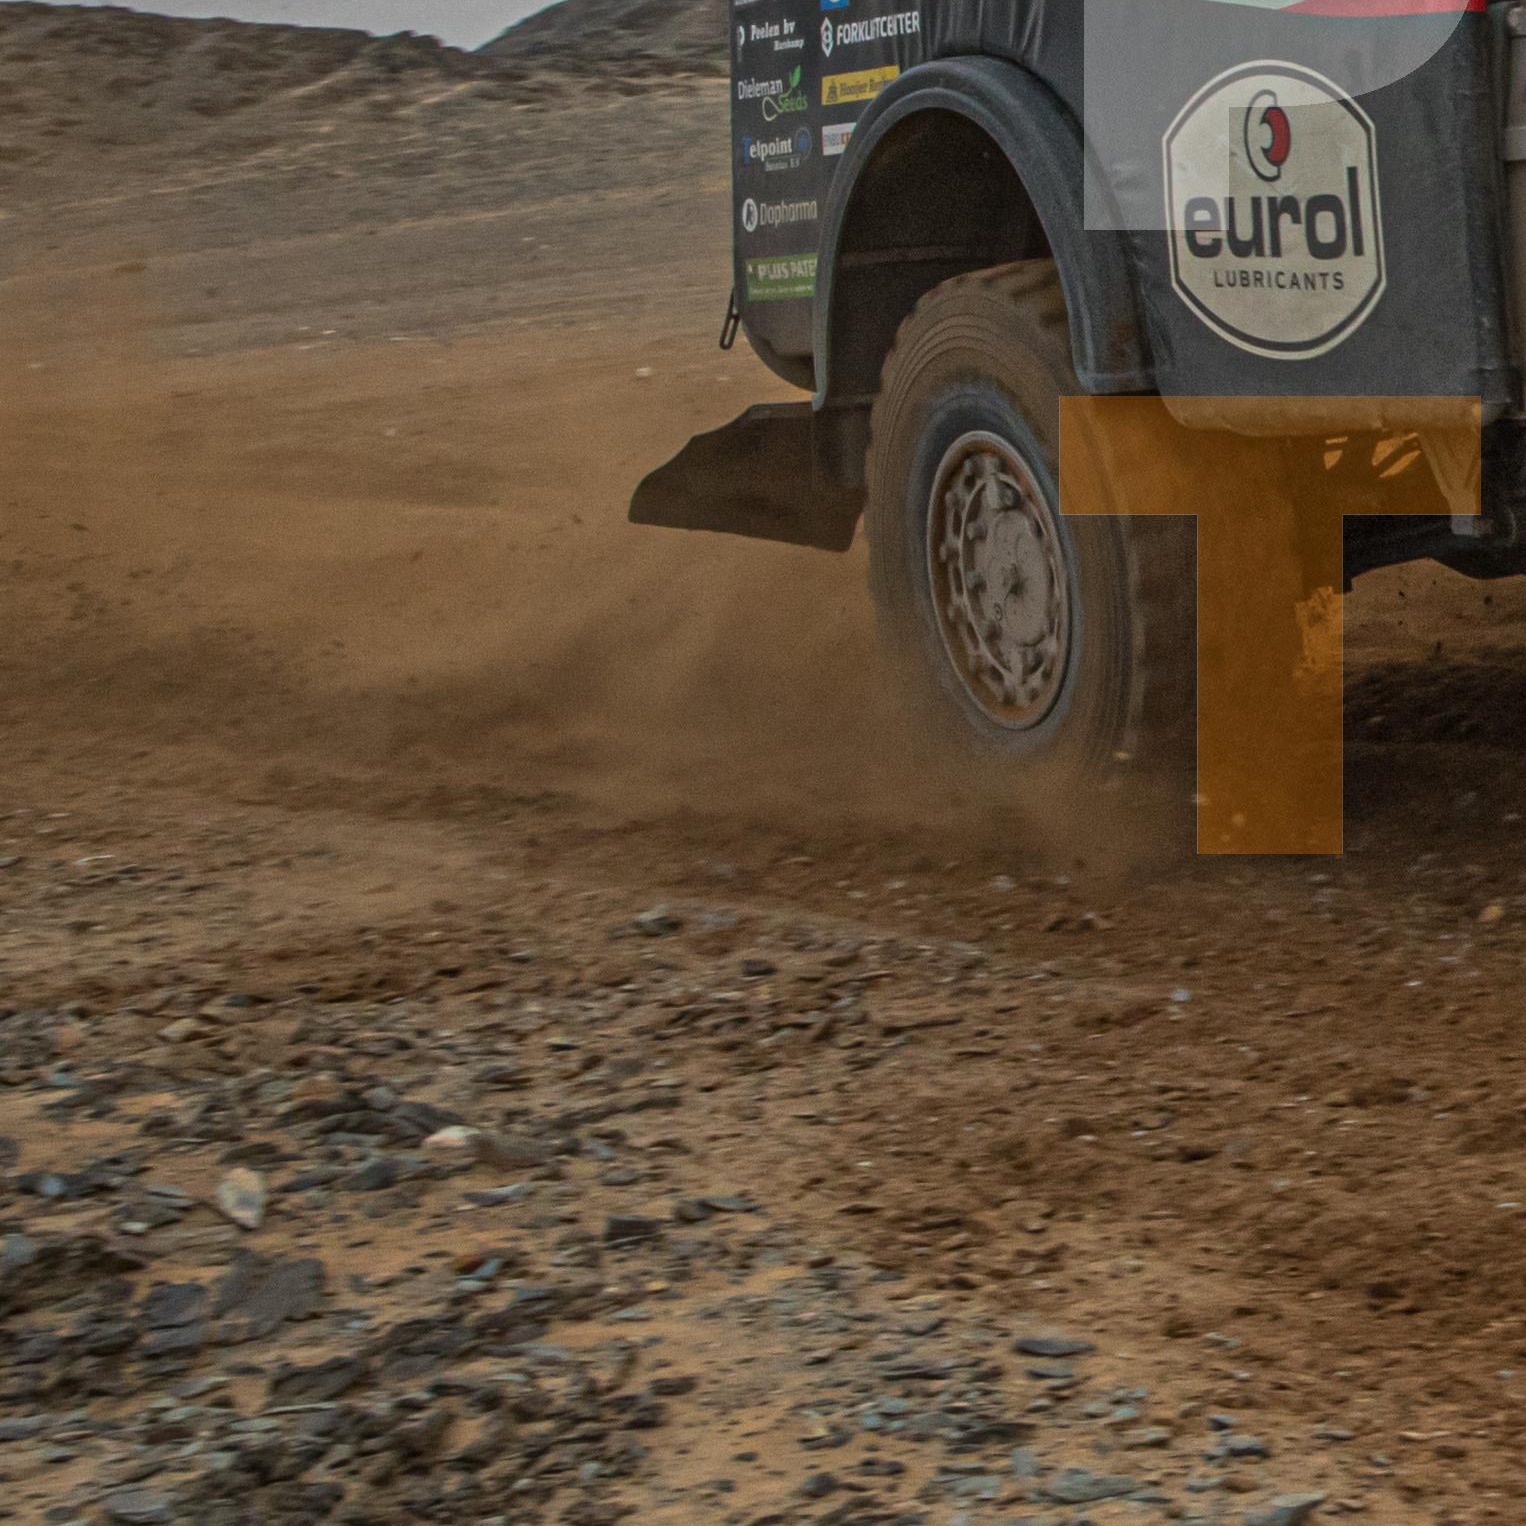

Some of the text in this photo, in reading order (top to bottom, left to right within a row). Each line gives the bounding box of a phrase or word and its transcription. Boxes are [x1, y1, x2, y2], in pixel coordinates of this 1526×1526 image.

[760, 199, 818, 229] Dopharma
[1184, 166, 1365, 260] eurol
[1212, 270, 1345, 291] LUBRICANTS
